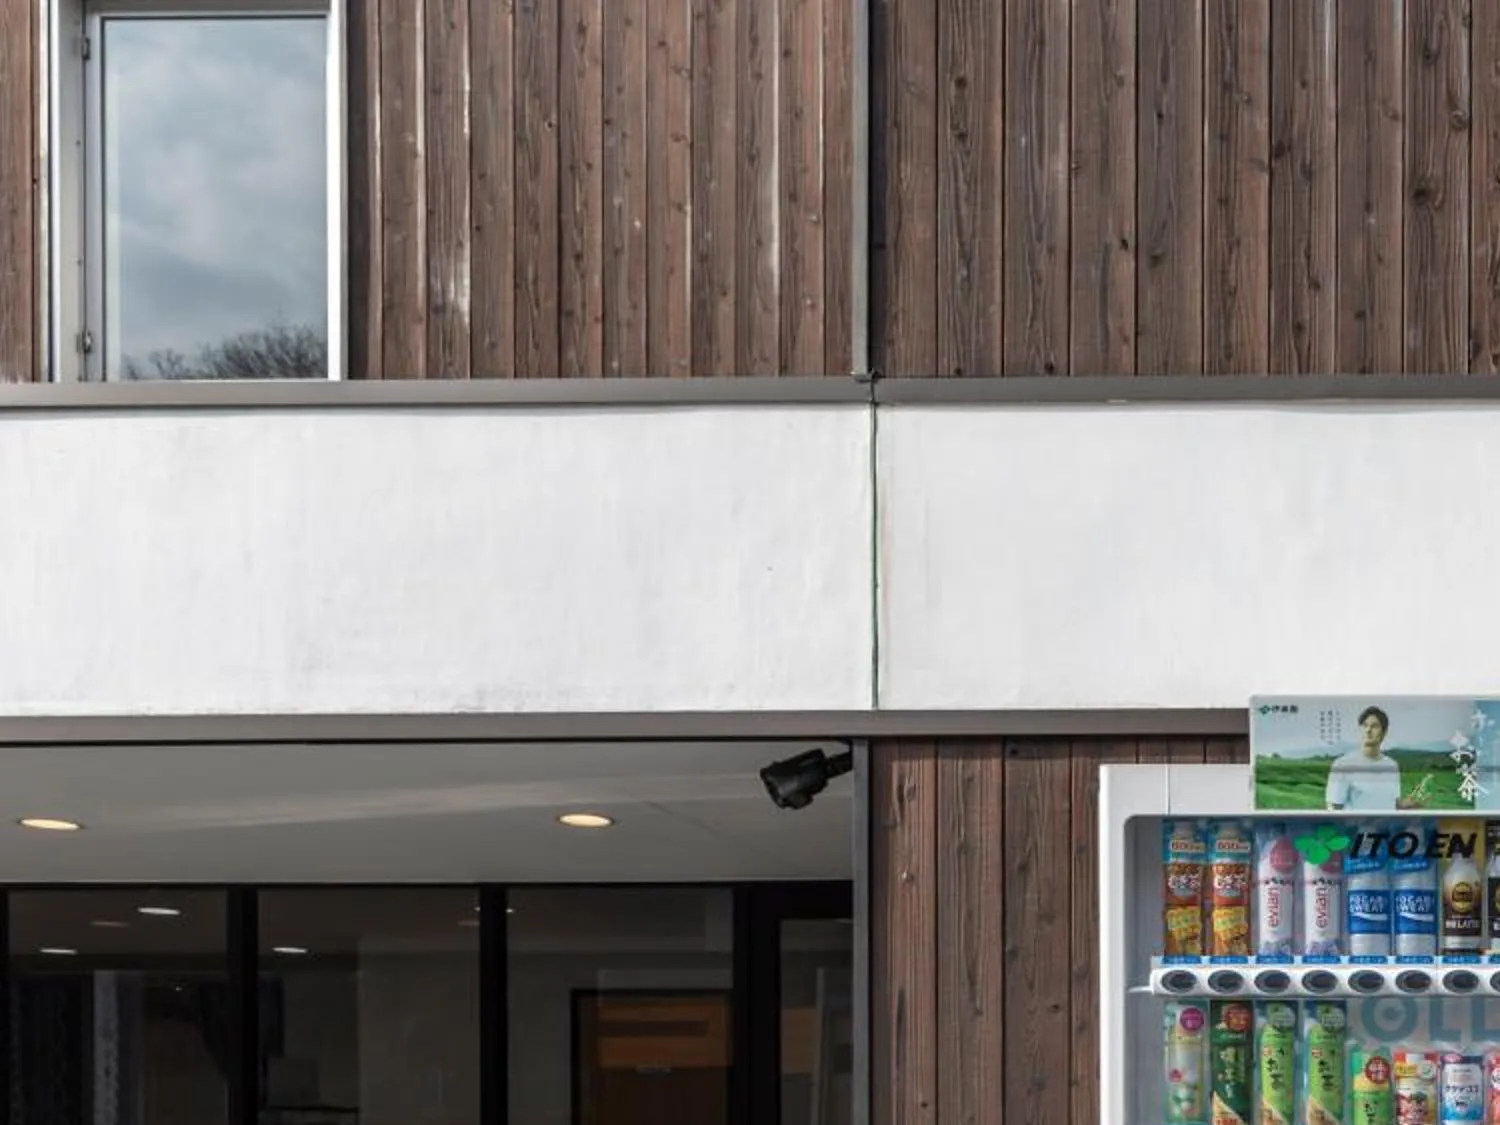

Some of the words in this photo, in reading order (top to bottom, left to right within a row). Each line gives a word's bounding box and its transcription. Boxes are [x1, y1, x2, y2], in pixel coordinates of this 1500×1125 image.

[1350, 831, 1419, 859] ITO
[1425, 832, 1478, 860] EN
[1266, 887, 1280, 929] evian
[1315, 886, 1328, 929] evian
